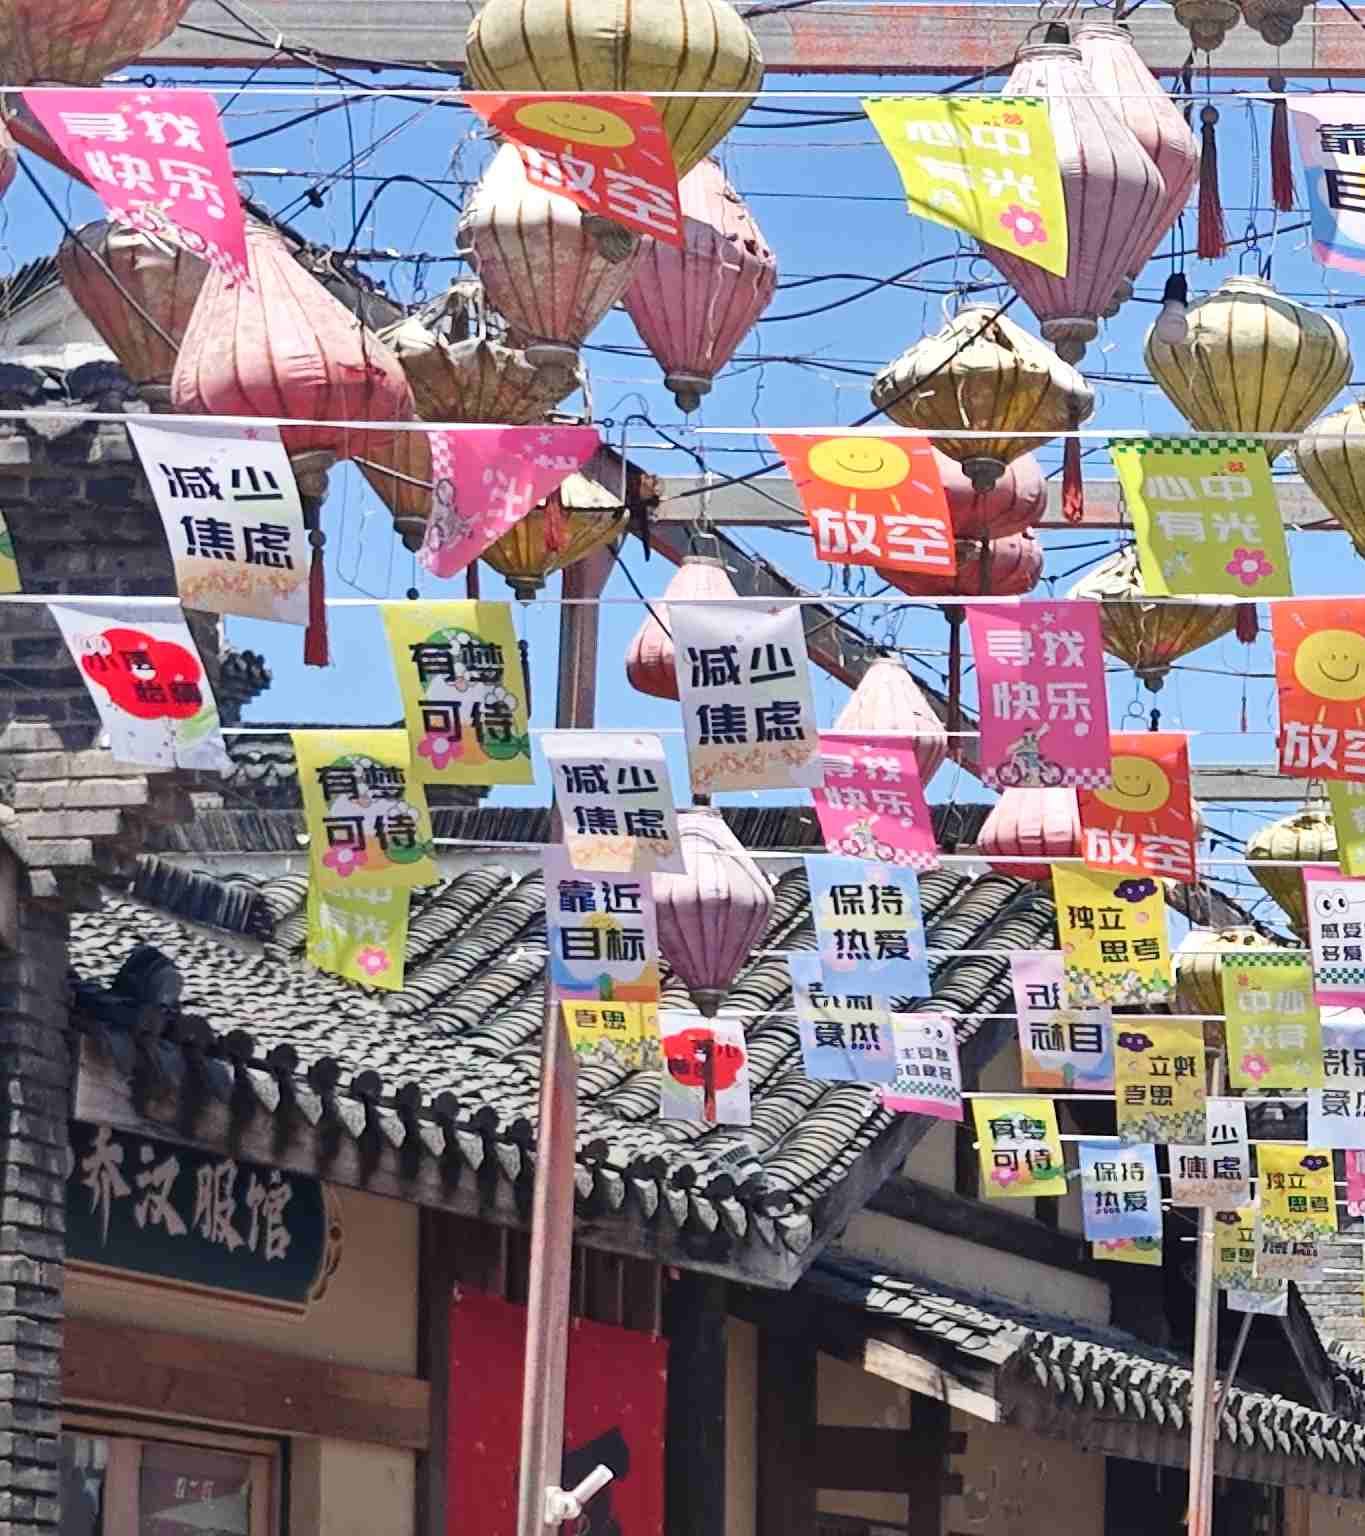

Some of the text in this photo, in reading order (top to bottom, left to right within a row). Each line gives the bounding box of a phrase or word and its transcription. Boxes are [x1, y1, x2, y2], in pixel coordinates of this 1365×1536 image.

[61, 111, 205, 153] 寻找
[905, 119, 1032, 158] 心中
[86, 152, 225, 219] 快乐
[165, 461, 283, 502] 减少
[1146, 475, 1254, 502] 心中
[180, 515, 294, 570] 焦虑
[812, 507, 954, 566] 放空
[1156, 512, 1263, 544] 有光
[410, 641, 503, 682] 有梦
[686, 643, 796, 688] 减少
[986, 629, 1086, 668] 寻找
[992, 681, 1094, 722] 快乐
[417, 699, 515, 743] 可待
[696, 700, 805, 743] 焦虑
[317, 765, 406, 801] 有梦
[563, 763, 658, 796] 减少
[824, 786, 914, 818] 快乐
[321, 814, 419, 851] 可待
[574, 806, 667, 840] 焦虑
[1083, 829, 1190, 877] 放空
[557, 881, 643, 915] 靠近
[829, 884, 904, 915] 保持
[1068, 904, 1126, 930] 独立
[560, 927, 645, 962] 目标
[832, 929, 912, 961] 热爱
[1100, 938, 1161, 964] 思考
[989, 1119, 1046, 1139] 有梦
[992, 1150, 1052, 1171] 可待
[1094, 1162, 1144, 1181] 保持
[1179, 1156, 1242, 1180] 焦虑
[1267, 1173, 1305, 1190] 独立
[1096, 1190, 1148, 1215] 热爱
[1289, 1196, 1329, 1212] 思考
